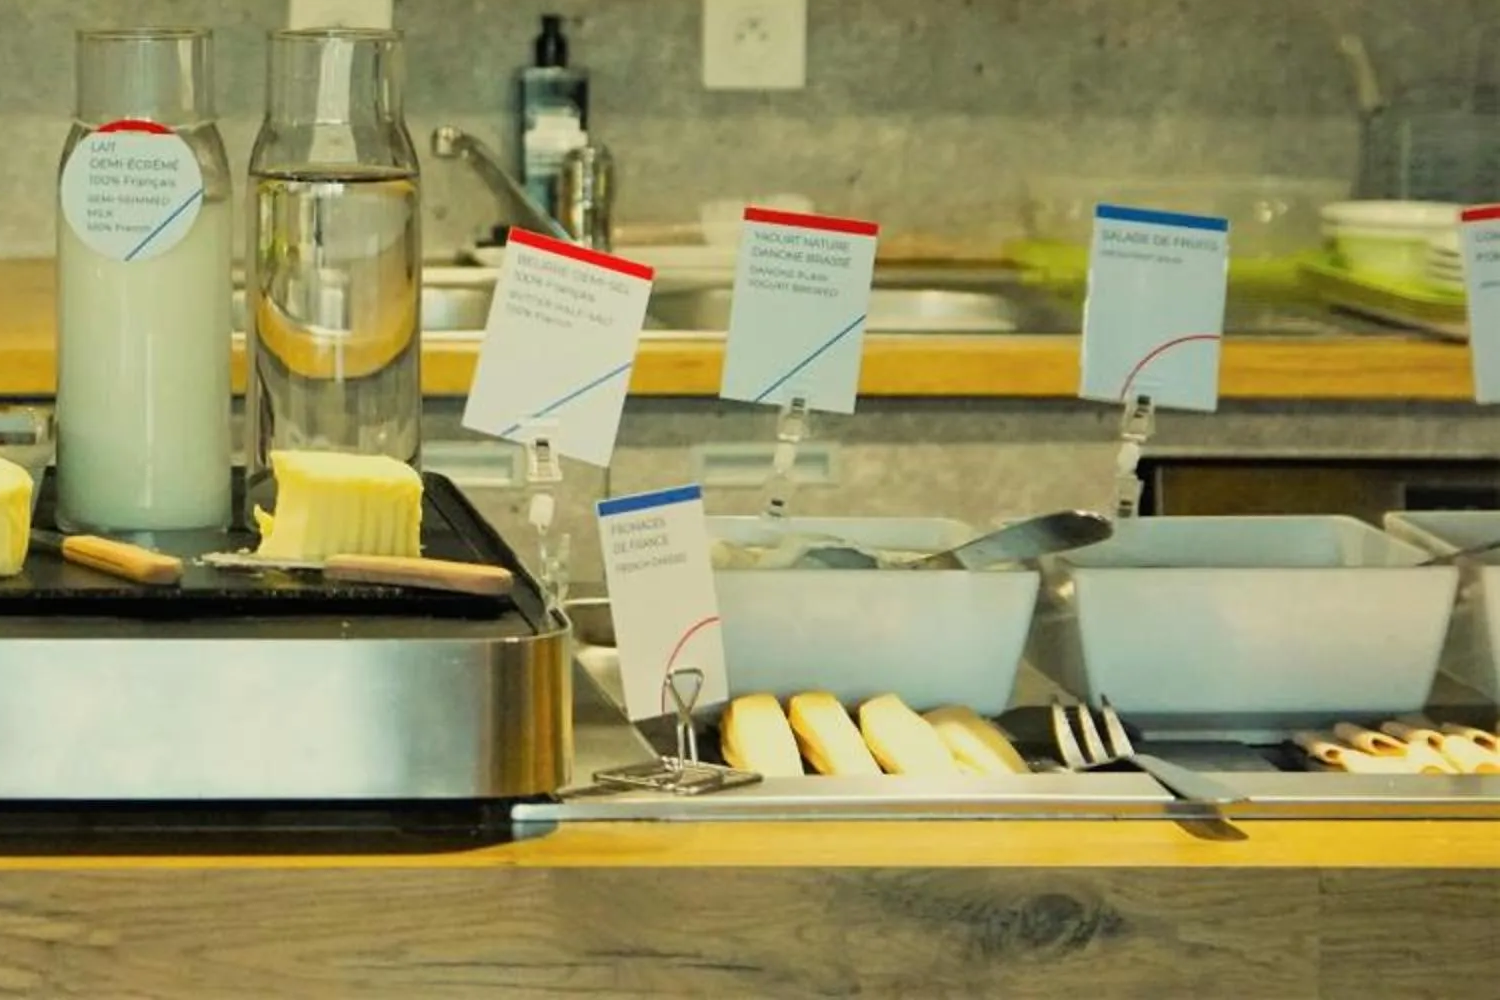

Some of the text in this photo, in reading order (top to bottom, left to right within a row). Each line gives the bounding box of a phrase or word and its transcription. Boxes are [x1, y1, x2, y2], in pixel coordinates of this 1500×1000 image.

[91, 140, 116, 153] LAIT
[89, 175, 176, 190] 100% Français
[754, 230, 850, 251] YAOURT NATURE
[1102, 229, 1149, 245] SALADE
[1152, 233, 1170, 246] DE
[751, 245, 804, 261] DANONE
[611, 517, 667, 536] FROMAGES
[613, 534, 670, 555] DE FRANCE
